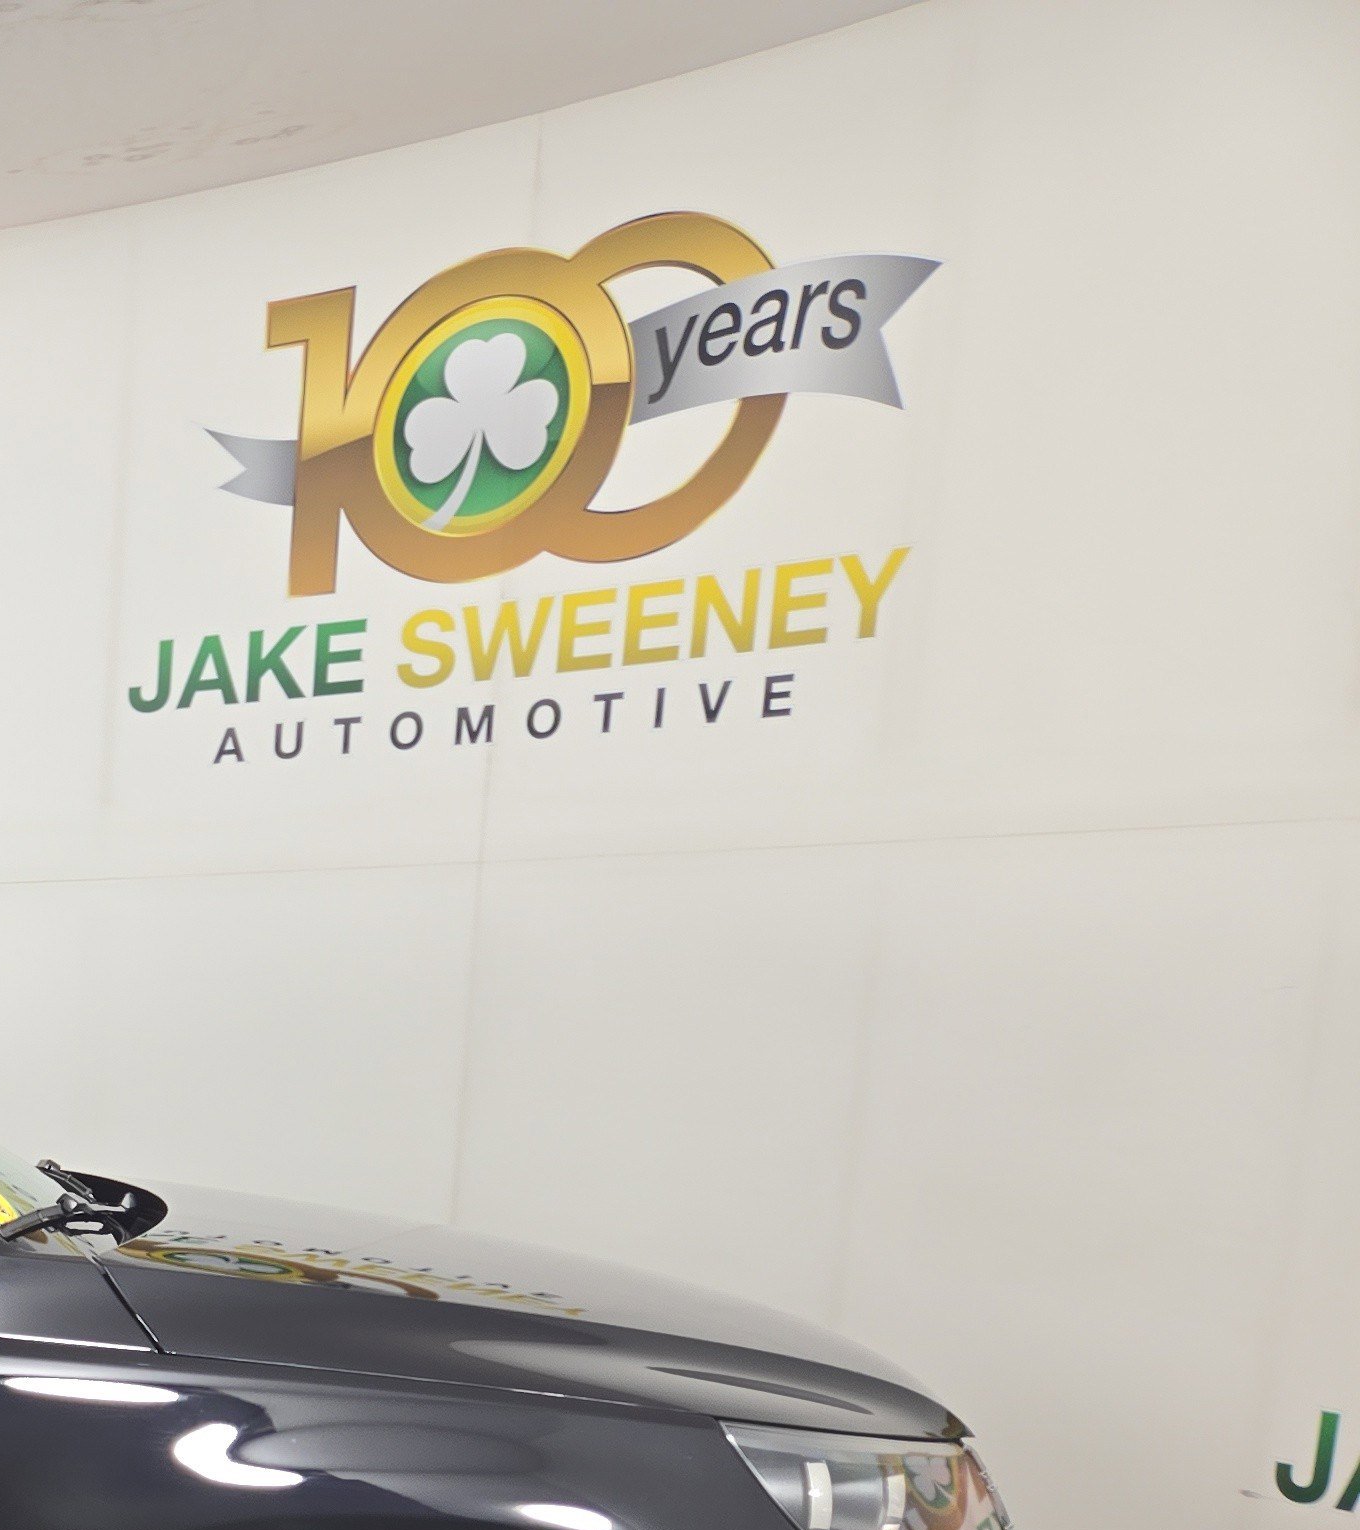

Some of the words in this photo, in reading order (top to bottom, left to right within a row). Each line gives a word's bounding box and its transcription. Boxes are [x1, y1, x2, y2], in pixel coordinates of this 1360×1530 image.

[648, 277, 866, 405] years
[128, 619, 368, 713] JAKE
[396, 546, 912, 689] SWEENEY
[214, 674, 796, 764] AUTOMOTIVE
